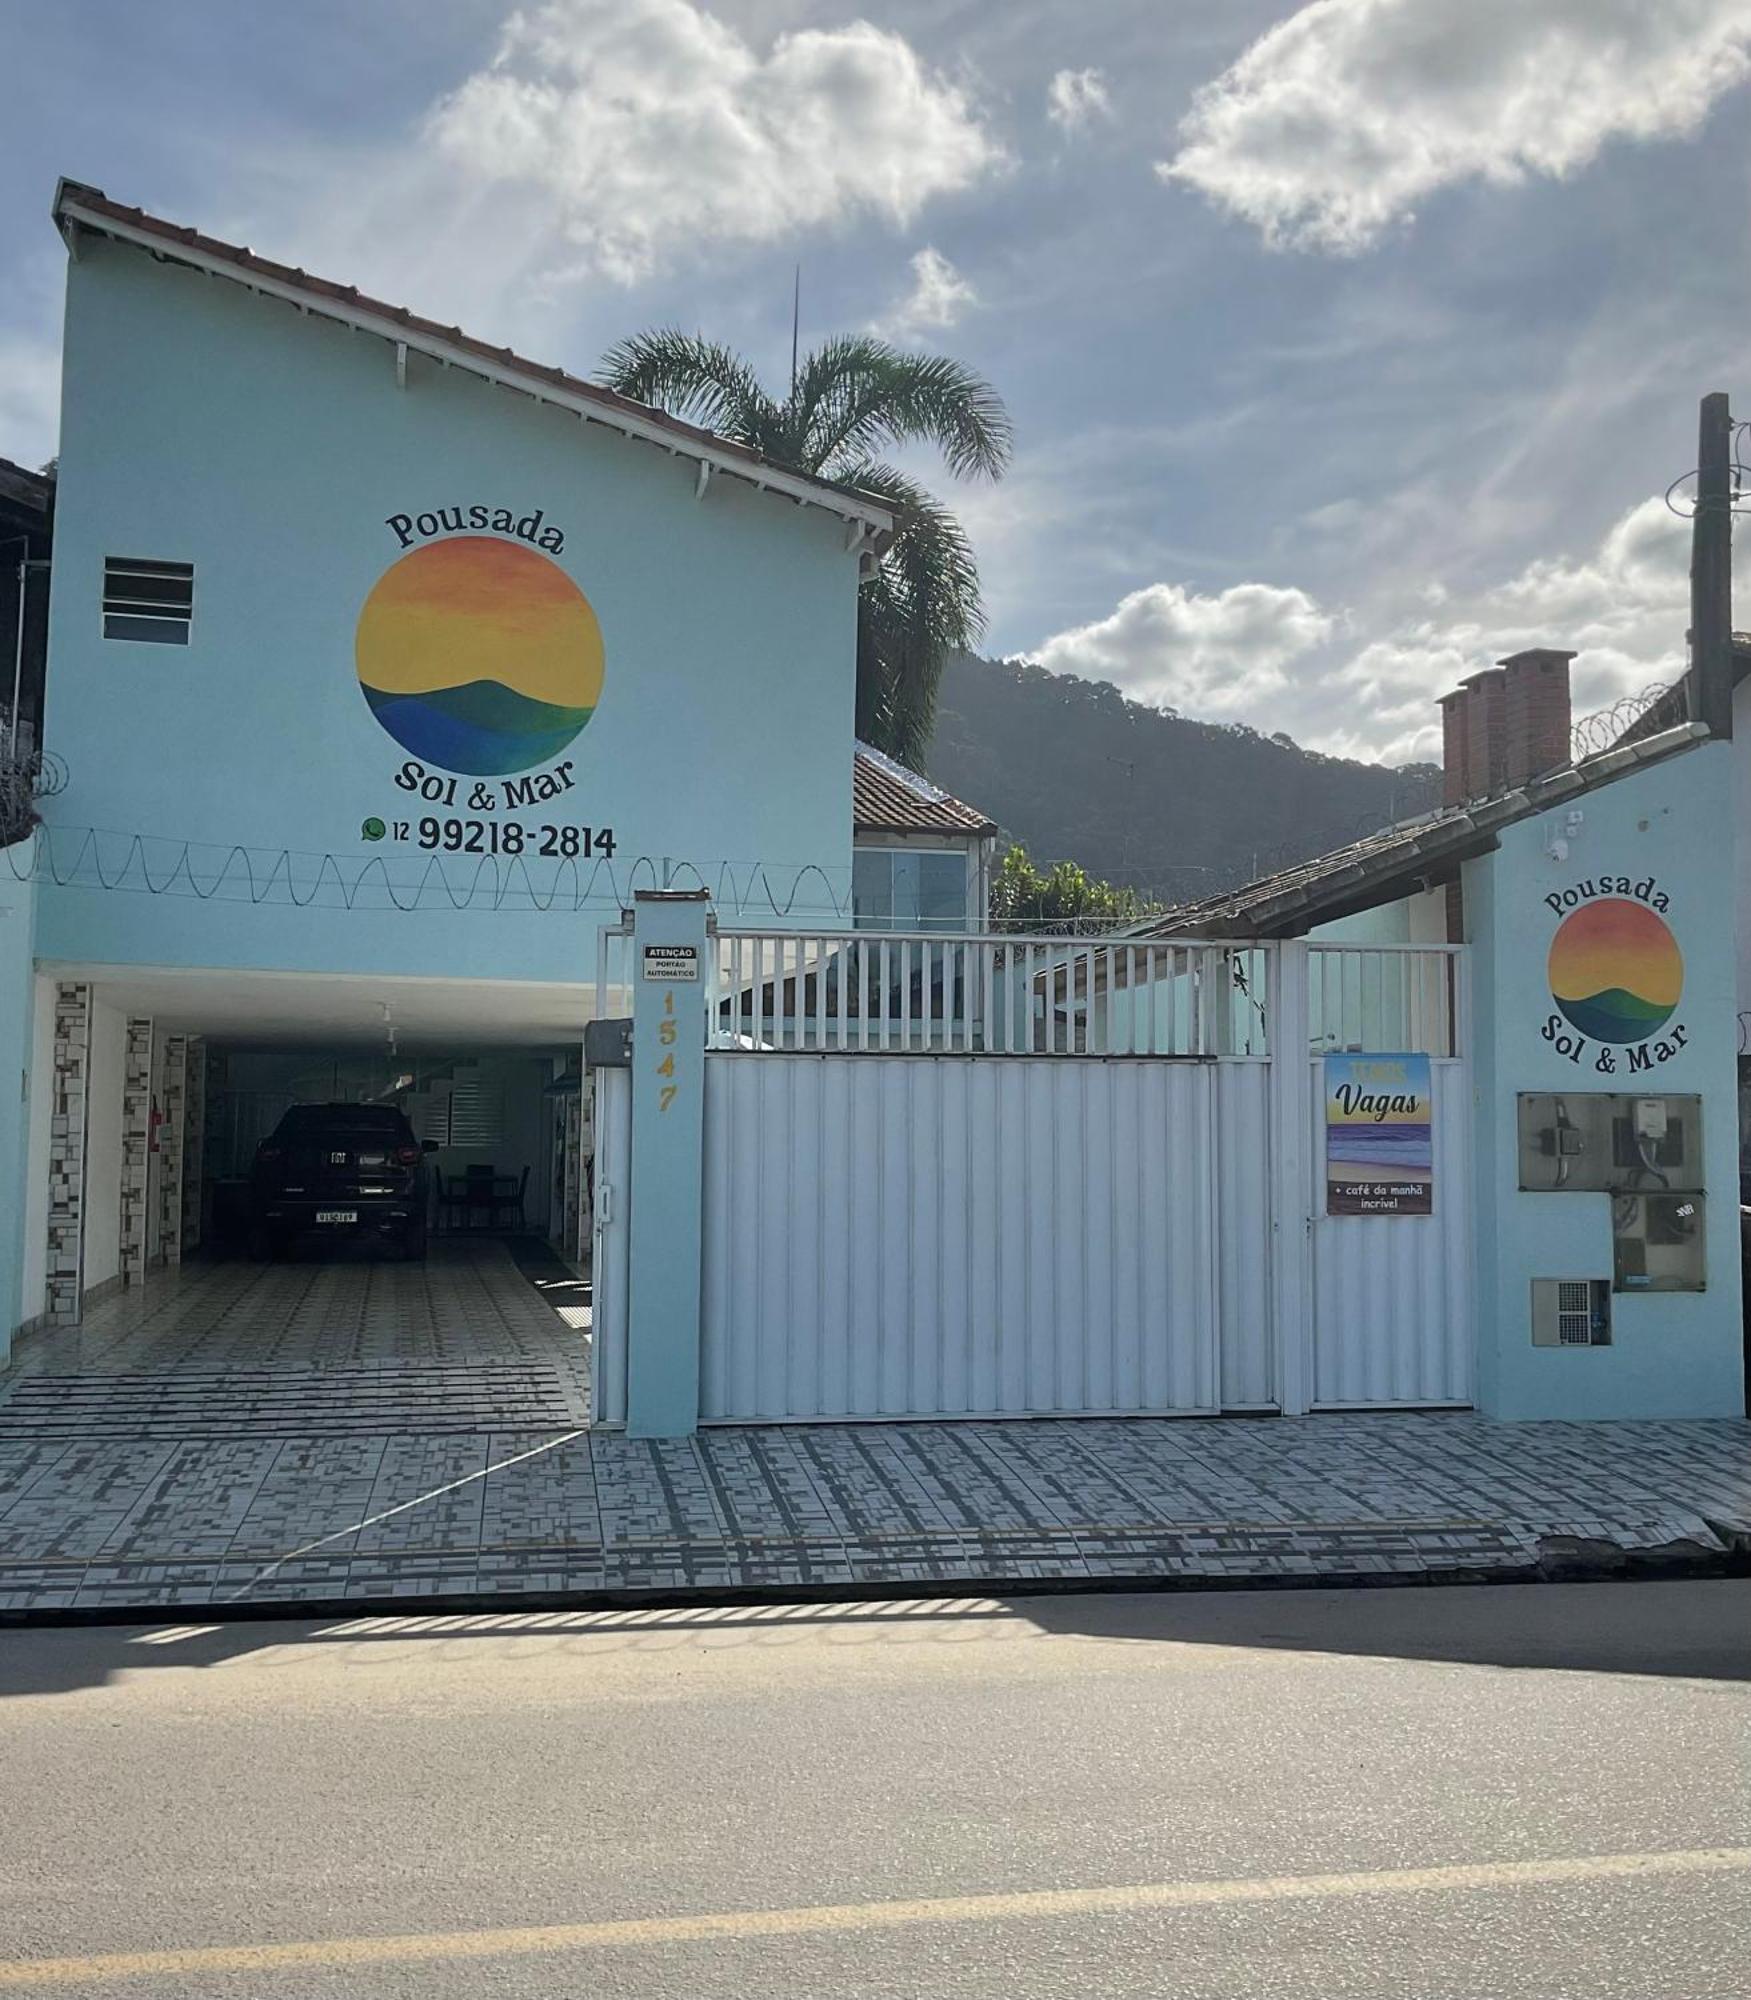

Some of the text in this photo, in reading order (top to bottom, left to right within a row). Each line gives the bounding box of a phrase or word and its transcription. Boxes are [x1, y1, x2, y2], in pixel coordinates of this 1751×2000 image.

[385, 505, 565, 555] Pousada
[394, 761, 576, 811] Sol & Mar
[393, 816, 617, 858] 12 99218-2814
[1544, 876, 1670, 918] Pousada
[1541, 1014, 1688, 1074] Sol & Mar
[1335, 1084, 1420, 1122] Vagas
[1346, 1183, 1423, 1196] café da manhã
[1360, 1197, 1399, 1209] incrível
